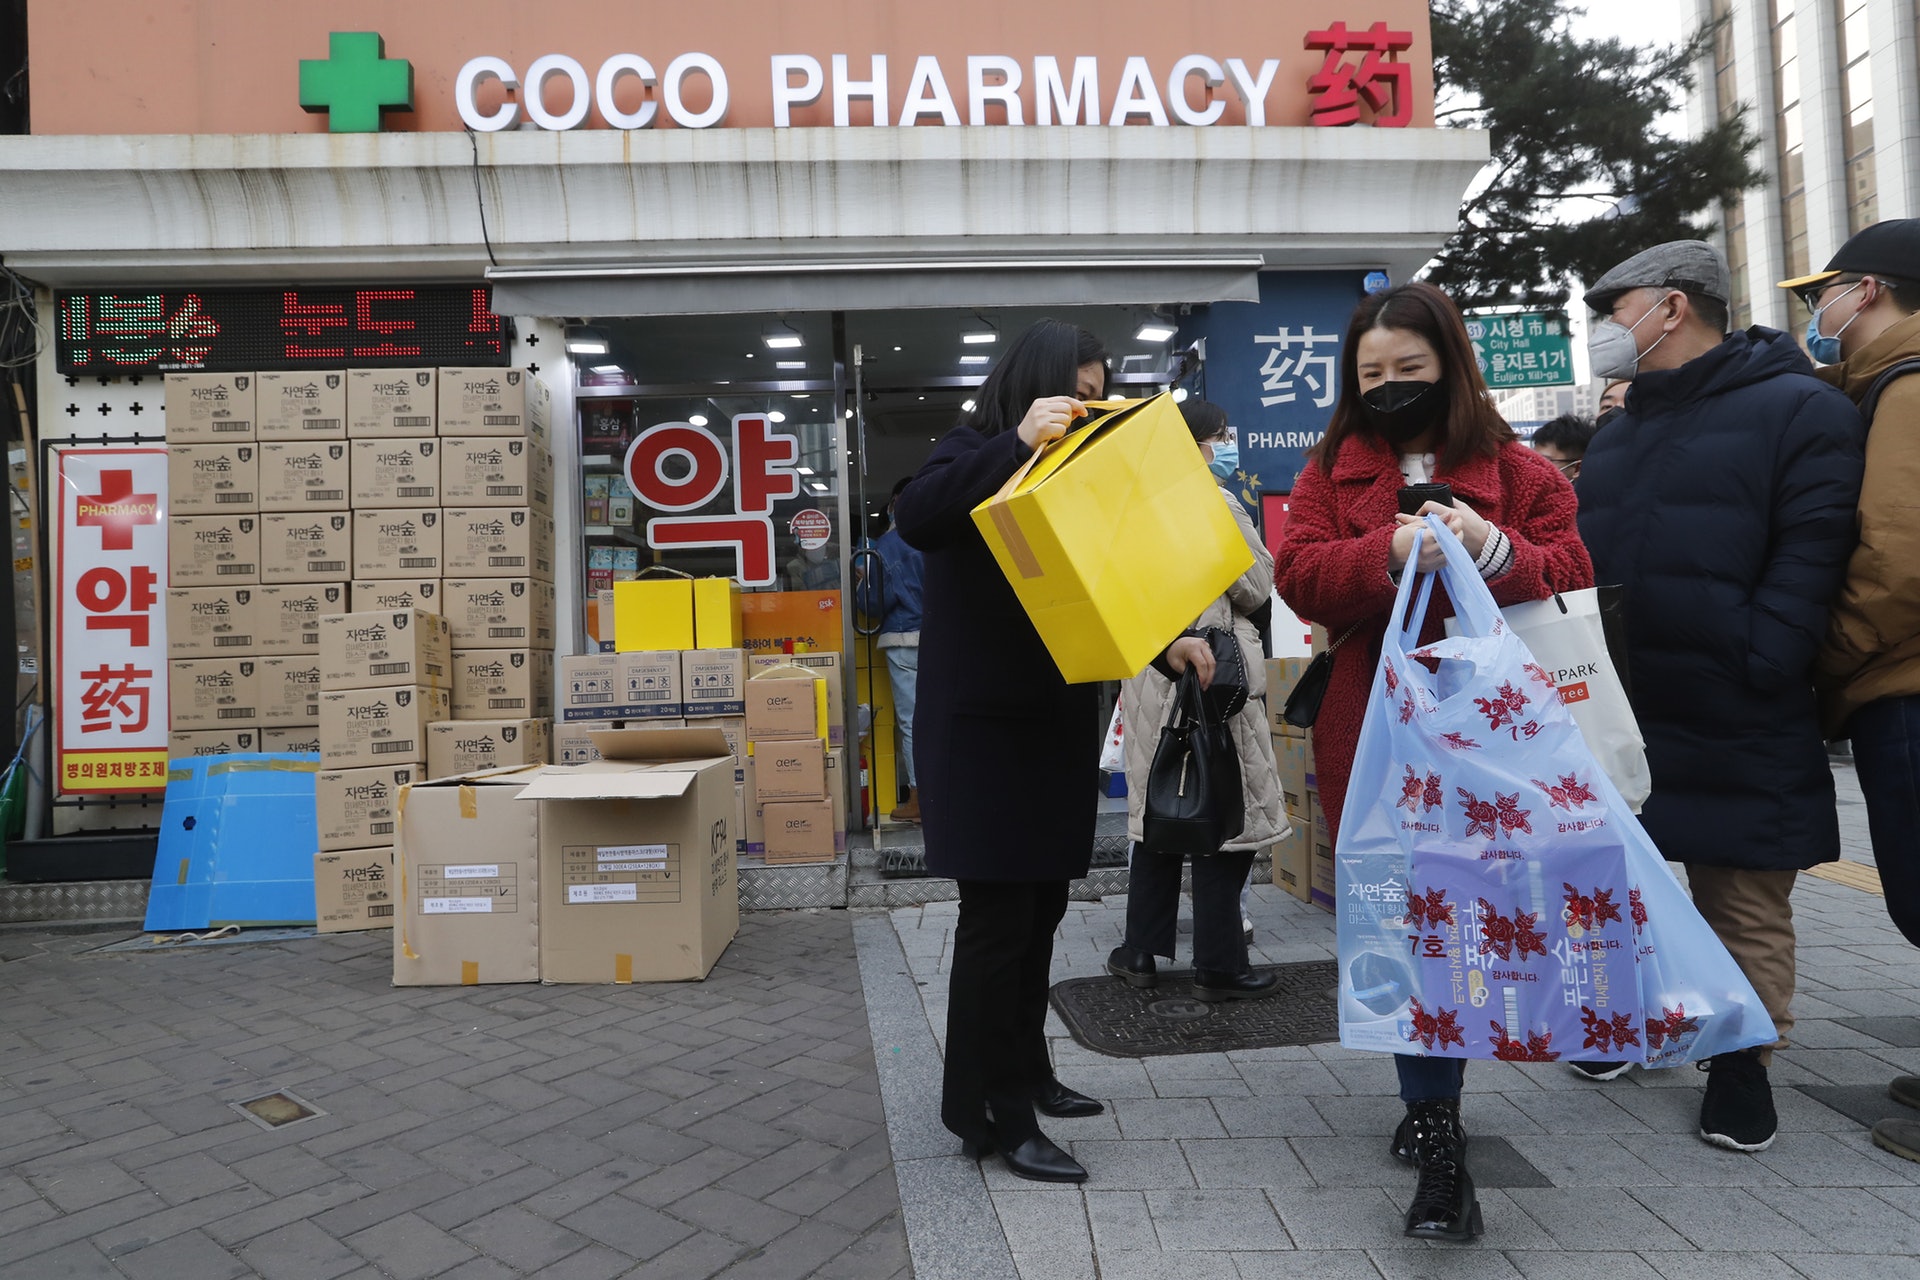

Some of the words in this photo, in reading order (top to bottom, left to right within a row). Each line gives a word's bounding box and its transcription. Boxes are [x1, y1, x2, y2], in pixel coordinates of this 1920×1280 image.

[1304, 21, 1413, 127] 药
[455, 52, 730, 132] COCO
[771, 54, 1281, 128] PHARMACY
[1468, 325, 1479, 337] 31
[1489, 319, 1525, 338] 시청
[1490, 340, 1508, 351] City
[1513, 339, 1530, 348] Hall
[1254, 326, 1339, 408] 药
[1491, 350, 1566, 372] 을지로1가
[1493, 372, 1524, 383] Euljiro
[191, 383, 228, 399] 자연숲
[282, 381, 319, 397] 자연숲
[373, 379, 409, 395] 자연숲
[464, 378, 500, 394] 자연숲
[1248, 431, 1326, 449] PHARMA
[194, 455, 231, 471] 자연숲
[285, 452, 322, 468] 자연숲
[376, 449, 413, 465] 자연숲
[466, 448, 502, 464] 자연숲
[624, 413, 800, 586] 약
[79, 503, 155, 517] PHARMACY
[195, 526, 232, 542] 자연숲
[287, 523, 324, 539] 자연숲
[379, 520, 415, 536] 자연숲
[468, 519, 504, 535] 자연숲
[76, 566, 157, 646] 약
[192, 598, 229, 614] 자연숲
[282, 595, 318, 611] 자연숲
[377, 591, 413, 607] 자연숲
[468, 590, 504, 606] 자연숲
[819, 599, 834, 609] gsk
[346, 624, 386, 641] 자연숲
[468, 661, 504, 677] 자연숲
[196, 670, 233, 686] 자연숲
[80, 664, 152, 734] 药
[1562, 688, 1584, 700] ree
[347, 701, 388, 719] 자연숲
[1505, 719, 1545, 741] 7호
[455, 736, 494, 752] 자연숲
[345, 781, 386, 799] 자연숲
[1557, 819, 1607, 833] 감사합니다.
[711, 816, 727, 857] KF94
[1480, 850, 1524, 860] 감사합니다.
[342, 863, 384, 881] 자연숲
[1348, 878, 1403, 902] 자연숲
[1408, 935, 1447, 958] 7호
[1492, 970, 1540, 982] 감사합니다.
[1550, 937, 1590, 1008] 푸른숲
